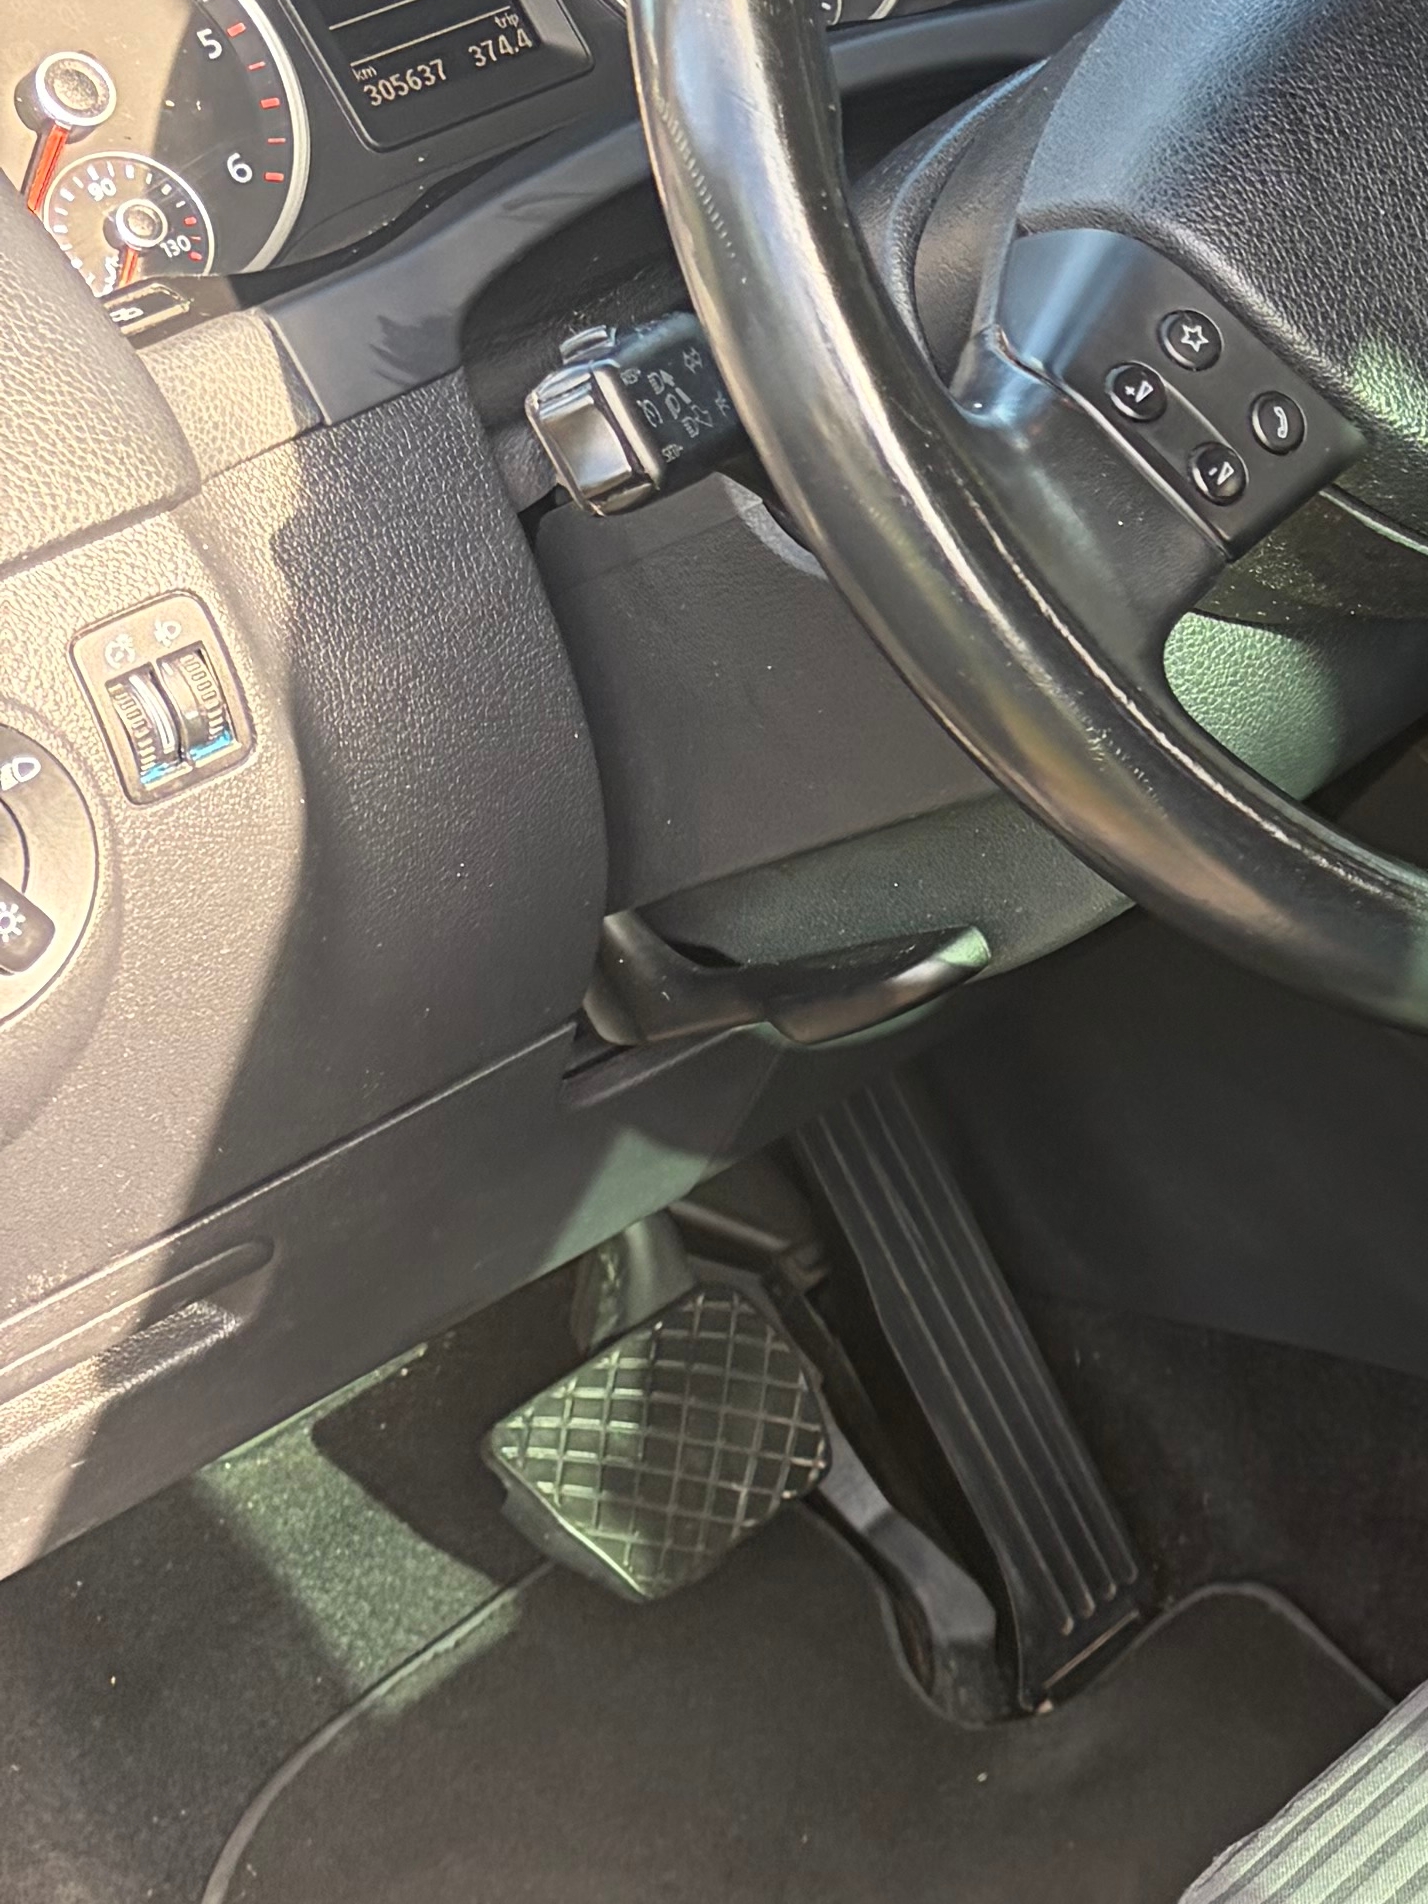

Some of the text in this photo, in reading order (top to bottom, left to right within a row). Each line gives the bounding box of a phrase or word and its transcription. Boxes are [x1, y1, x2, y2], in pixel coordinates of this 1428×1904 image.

[494, 12, 520, 29] trip
[196, 28, 223, 60] 5
[468, 28, 532, 67] 374.4
[352, 65, 377, 82] km
[363, 58, 447, 106] 305637
[226, 152, 253, 183] 6
[87, 177, 117, 202] 90
[159, 235, 192, 258] 130
